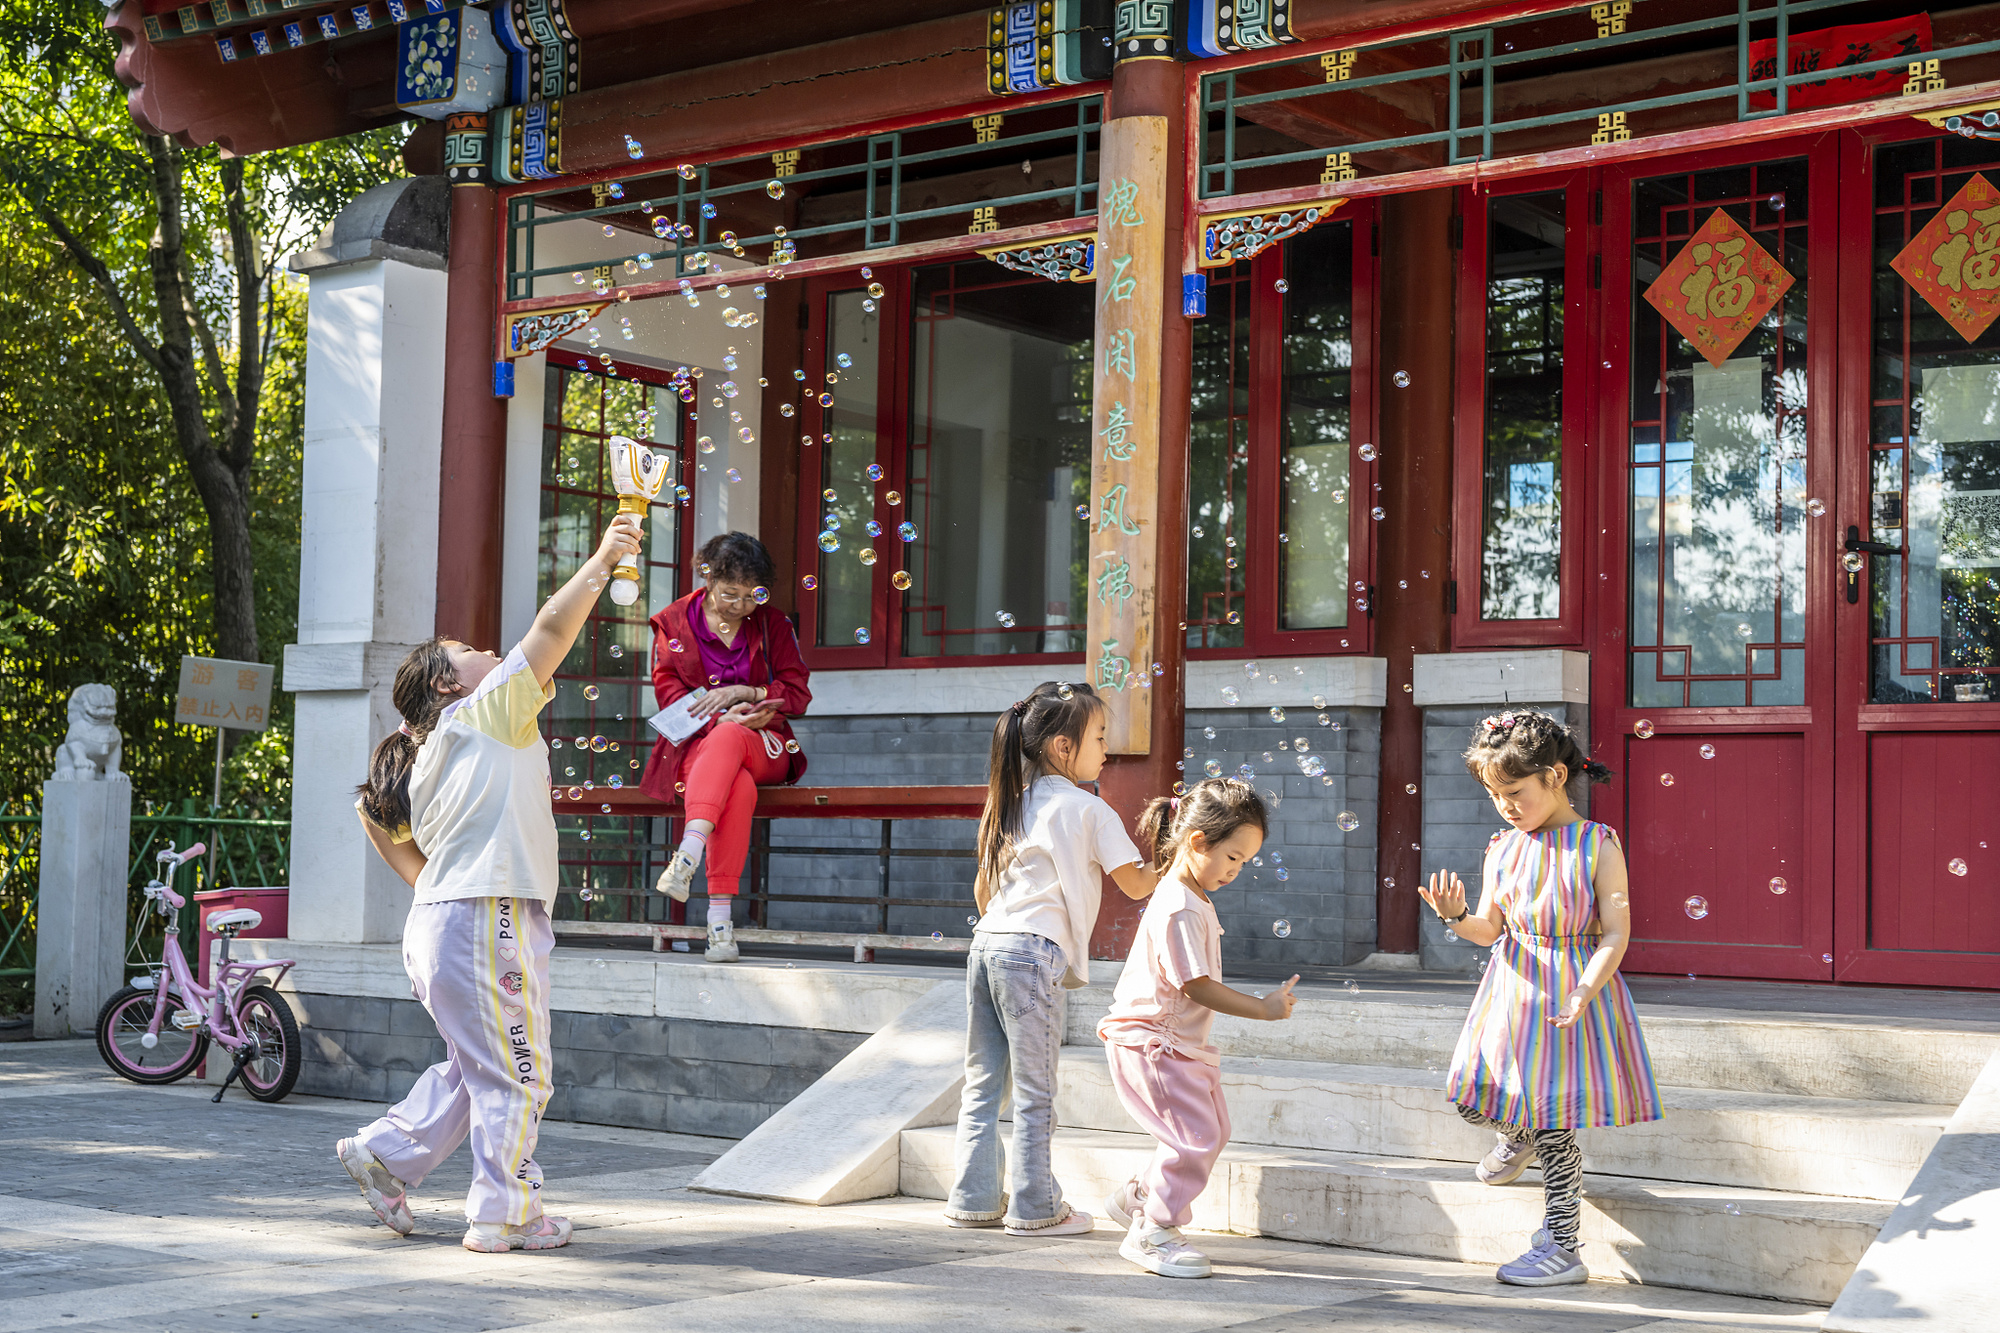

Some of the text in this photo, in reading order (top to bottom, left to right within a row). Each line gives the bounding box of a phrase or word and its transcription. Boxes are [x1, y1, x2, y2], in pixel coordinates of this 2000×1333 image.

[1931, 209, 2000, 292] 福
[1680, 237, 1756, 320] 福
[192, 663, 259, 691] 游客
[179, 697, 263, 723] 禁止入内
[511, 1024, 535, 1084] POWER
[517, 1158, 541, 1190] PNY
